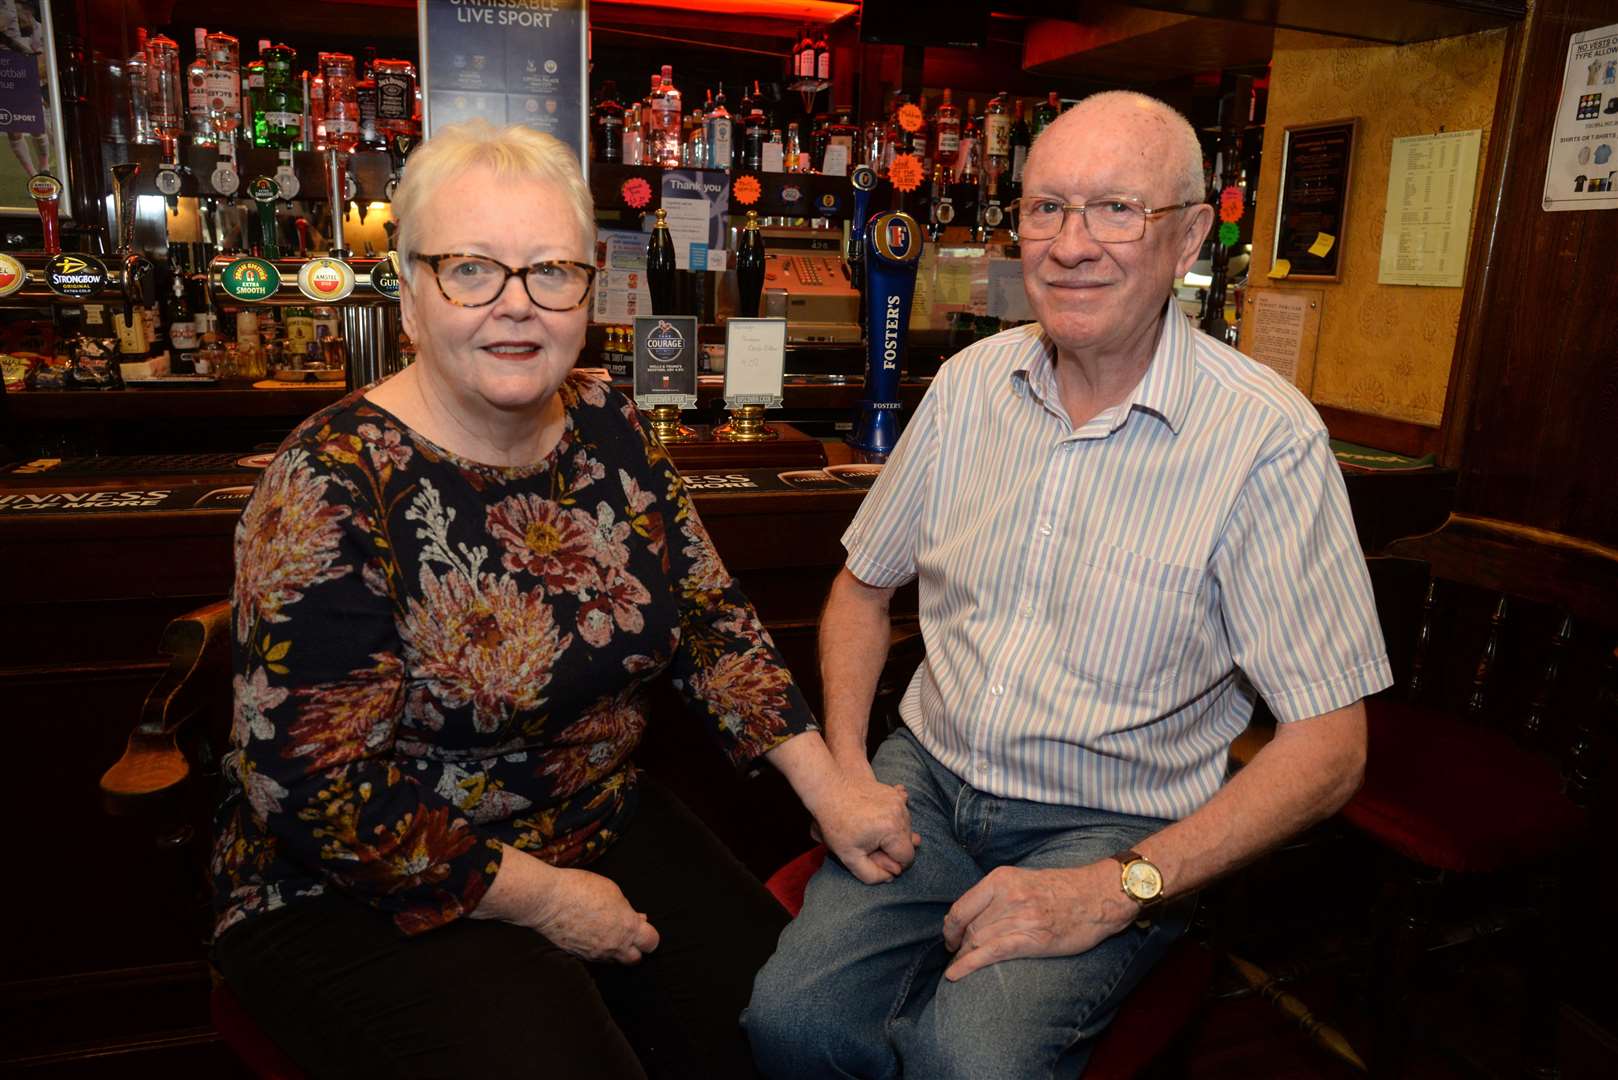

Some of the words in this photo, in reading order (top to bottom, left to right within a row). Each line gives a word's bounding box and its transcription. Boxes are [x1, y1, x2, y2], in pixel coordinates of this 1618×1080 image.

[457, 7, 494, 24] LIVE
[498, 10, 552, 27] SPORT
[1577, 44, 1588, 53] NO
[1590, 40, 1610, 50] VESTS
[1576, 52, 1593, 60] TYPE
[1594, 47, 1618, 57] ALLOW
[0, 69, 26, 78] otball
[671, 179, 699, 191] Thank
[702, 183, 722, 193] you
[53, 273, 100, 284] STRONGBOW
[380, 278, 399, 287] GUIN
[236, 287, 266, 295] SMOOTH
[884, 295, 900, 370] FOSTER'S
[647, 339, 682, 348] COURAGE
[0, 490, 172, 504] INNESS
[62, 499, 160, 509] MORE
